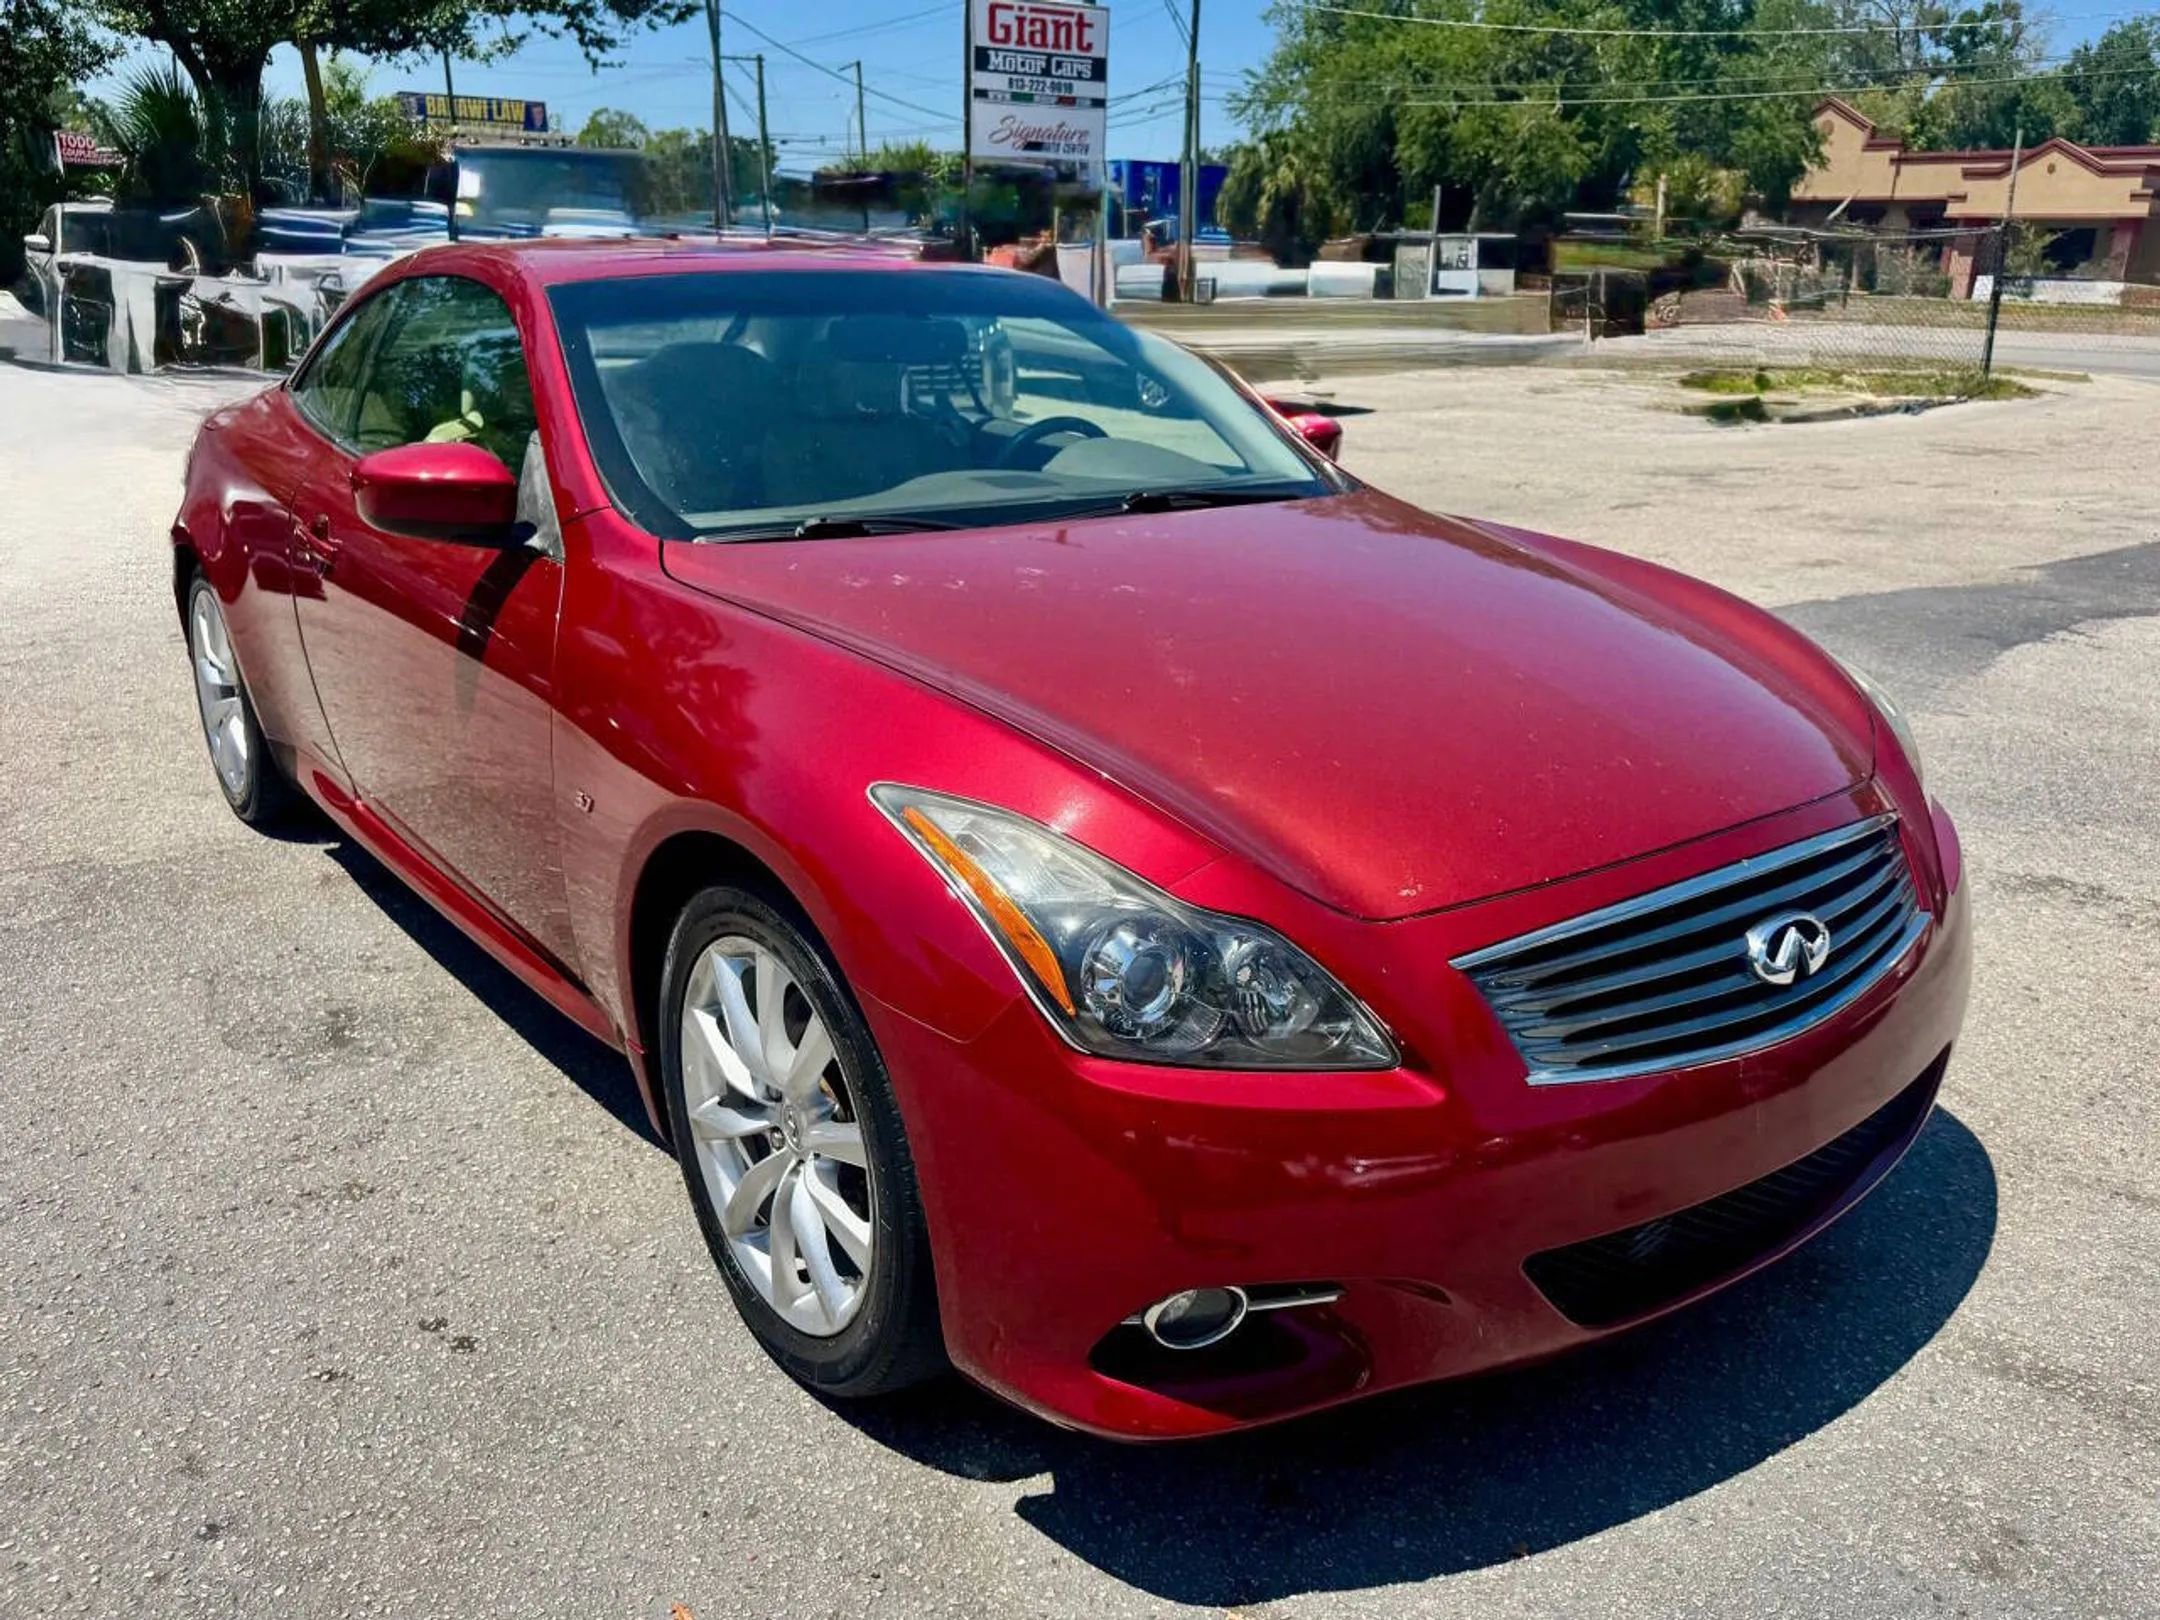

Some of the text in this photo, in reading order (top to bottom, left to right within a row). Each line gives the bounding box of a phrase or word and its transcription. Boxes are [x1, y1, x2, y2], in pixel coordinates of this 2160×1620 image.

[988, 3, 1094, 53] Giant
[988, 51, 1093, 79] Motor Cars
[494, 99, 525, 122] LAW
[988, 114, 1090, 151] Signature
